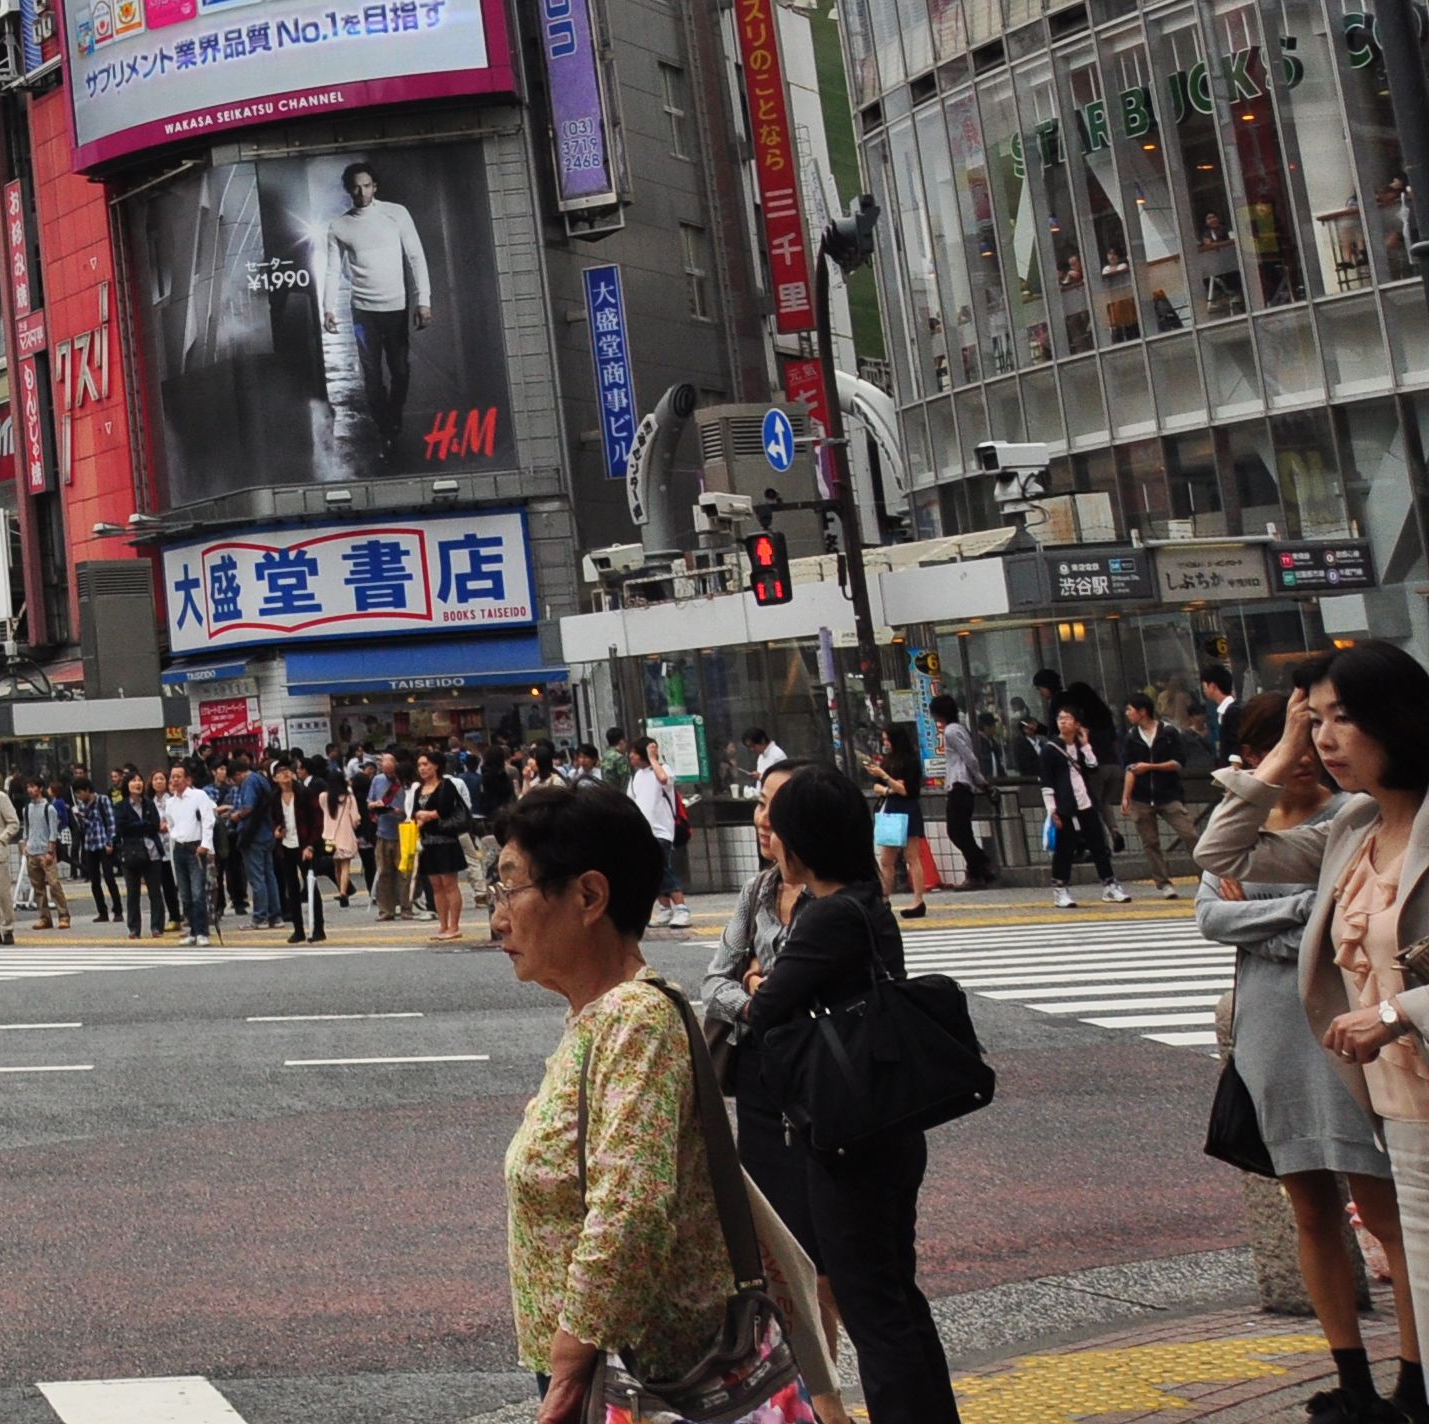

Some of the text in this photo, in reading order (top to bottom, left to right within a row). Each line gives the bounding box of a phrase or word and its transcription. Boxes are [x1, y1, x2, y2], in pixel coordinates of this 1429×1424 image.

[164, 90, 345, 135] WAKASA SEIKATSU CHANNEL
[562, 118, 595, 136] (03)
[562, 137, 599, 156] 3719
[564, 152, 601, 172] 2468
[9, 190, 29, 309] お好み焼
[764, 186, 810, 313] 三千里
[244, 258, 294, 273] セーター
[246, 268, 310, 292] ¥1,990
[590, 280, 630, 466] 大盛堂商事ビル
[23, 363, 43, 488] もんじゃ焼
[422, 407, 498, 462] H&M
[172, 532, 507, 633] 大盛堂書店
[1059, 576, 1111, 597] 渋谷駅
[443, 605, 528, 623] BOOKS TAISEIDO
[389, 677, 465, 690] TAISEIDO
